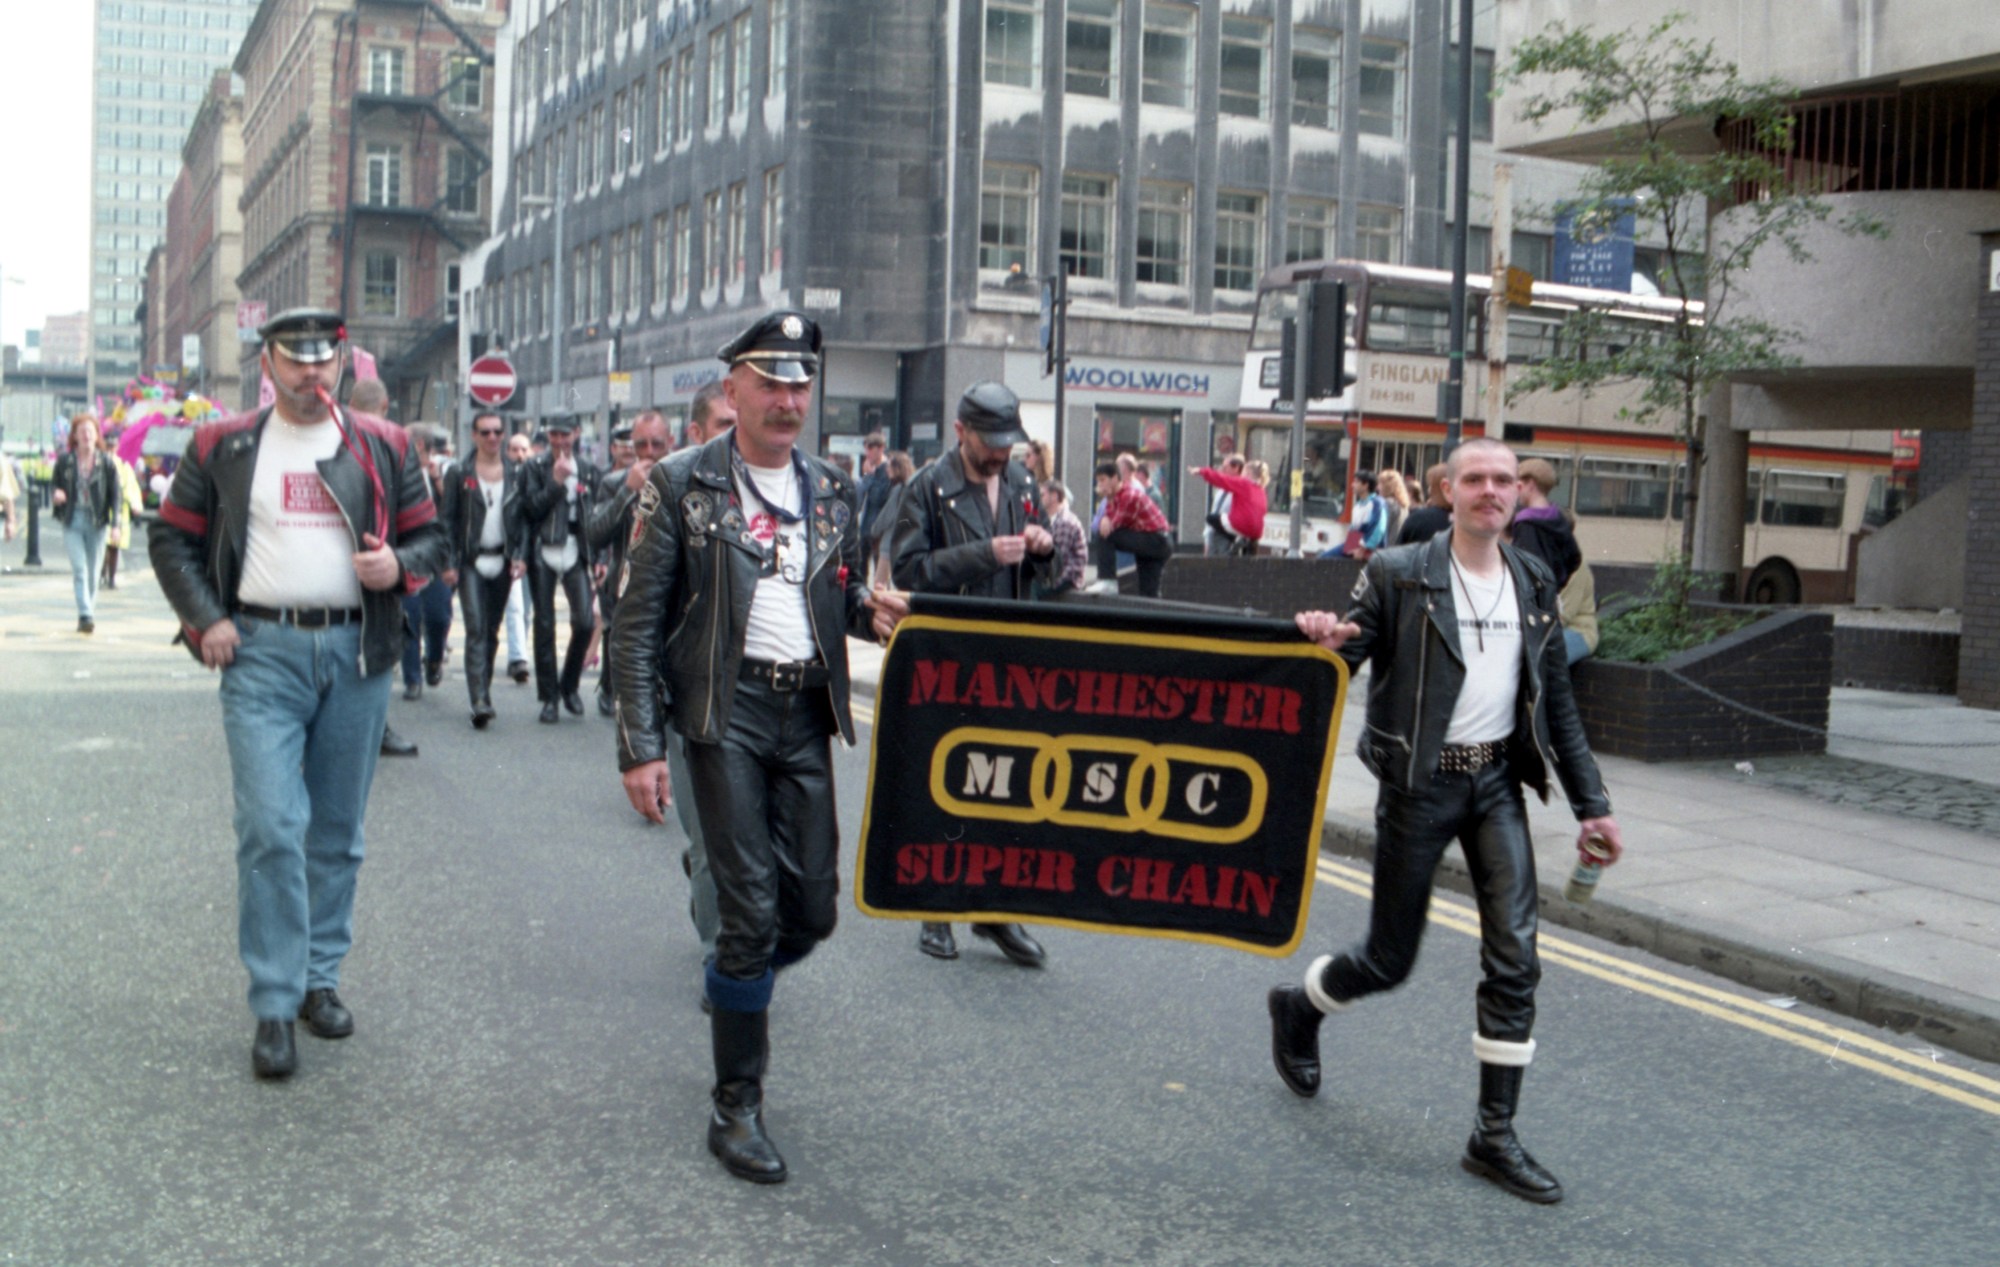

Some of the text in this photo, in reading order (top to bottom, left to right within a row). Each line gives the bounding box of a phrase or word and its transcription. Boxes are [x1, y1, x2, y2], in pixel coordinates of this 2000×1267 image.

[1065, 366, 1210, 392] WOOLWICH
[909, 659, 1302, 734] MANCHESTER
[962, 751, 1221, 815] M S C
[896, 843, 1280, 918] SUPER CHAIN
